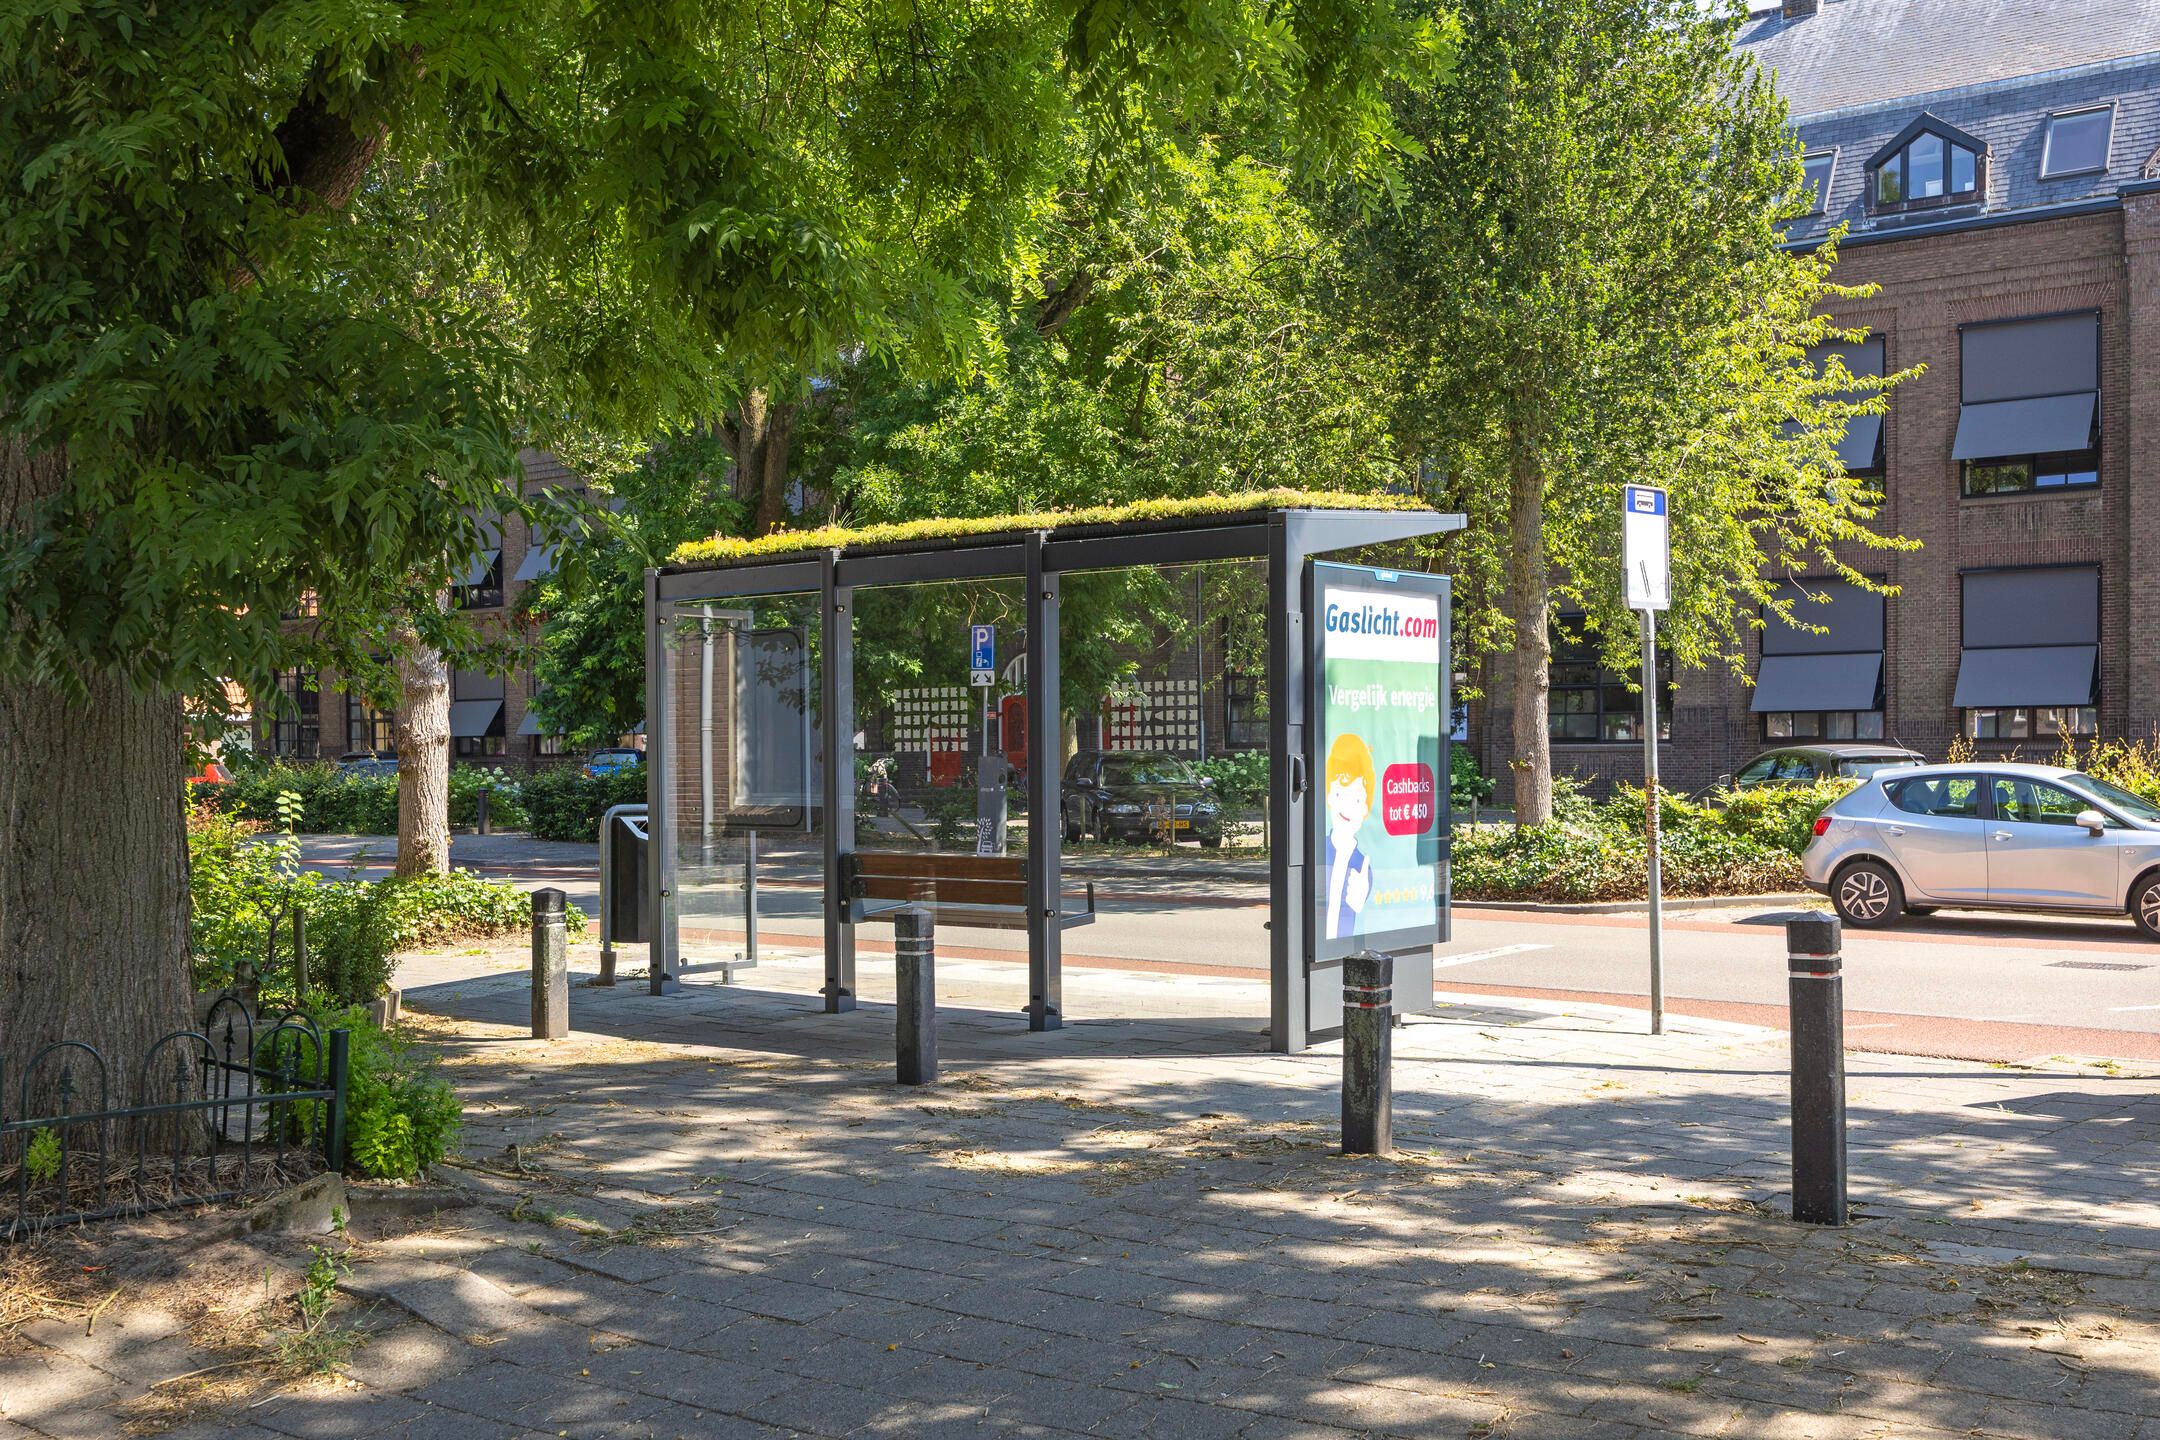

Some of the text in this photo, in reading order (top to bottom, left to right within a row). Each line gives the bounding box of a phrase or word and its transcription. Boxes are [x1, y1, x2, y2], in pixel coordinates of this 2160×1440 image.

[1325, 603, 1437, 639] Gaslicht.com
[976, 628, 989, 651] P
[1328, 684, 1436, 713] Vergelijk energie
[1387, 777, 1430, 795] Cashbacks
[1389, 805, 1403, 820] tot
[1411, 803, 1428, 819] 450
